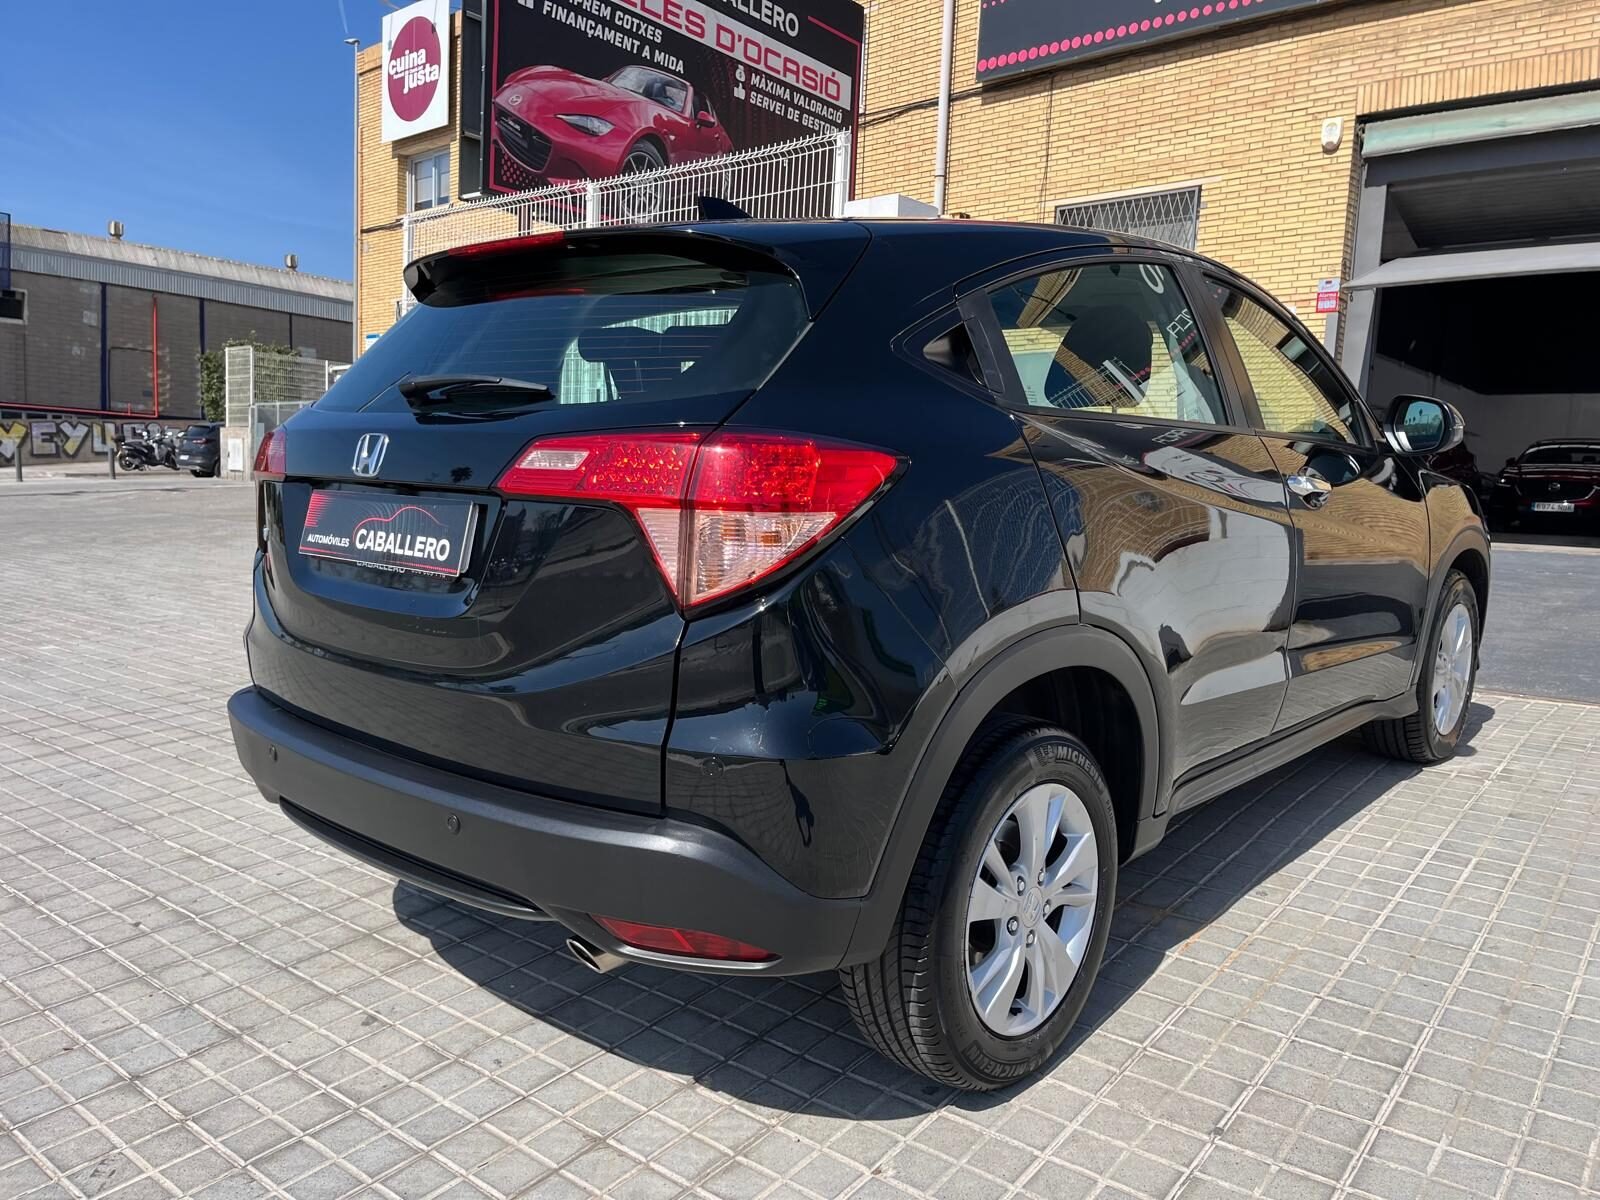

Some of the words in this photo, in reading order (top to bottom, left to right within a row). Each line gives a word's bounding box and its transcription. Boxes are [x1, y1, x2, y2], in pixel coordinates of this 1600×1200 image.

[542, 1, 641, 54] FINANÇAMENT
[642, 45, 651, 60] A
[653, 49, 685, 74] MIDA
[615, 10, 663, 43] COTXES
[388, 48, 426, 76] cuina
[403, 63, 440, 94] justa
[716, 23, 841, 102] D'OCASIÓ
[750, 72, 791, 102] MÀXIMA
[793, 91, 843, 124] VALORACIÓ
[750, 91, 785, 116] SERVEI
[787, 105, 800, 122] DE
[307, 533, 350, 547] AUTOMÓVILES
[355, 528, 451, 562] CABALLERO
